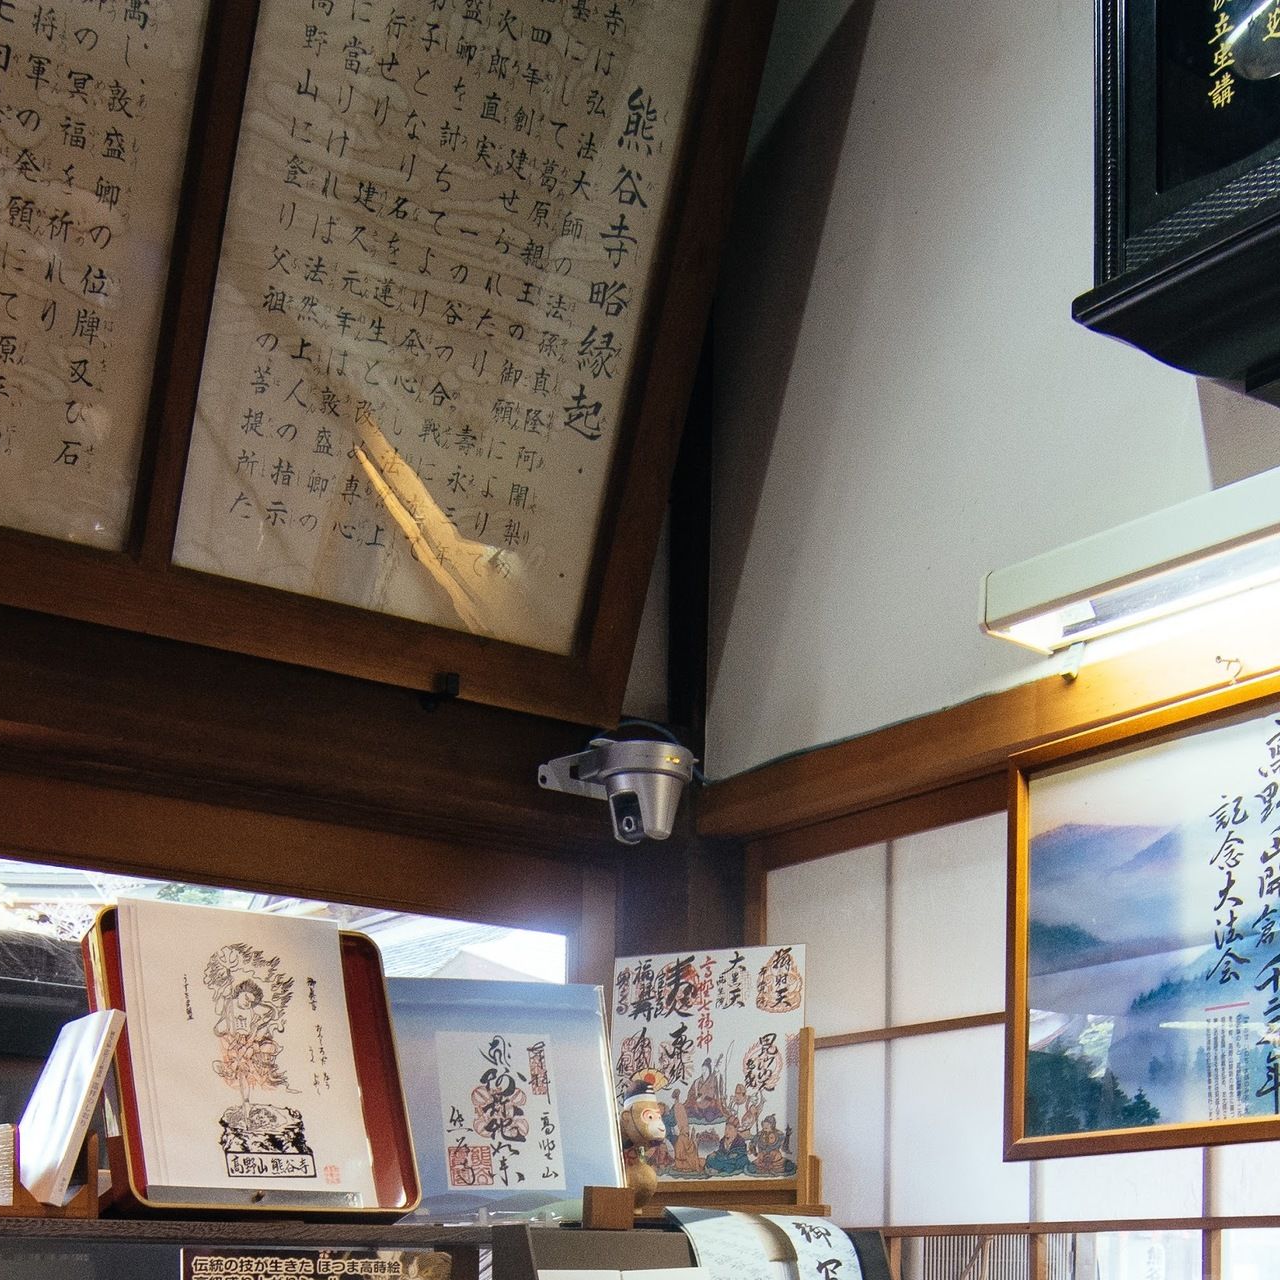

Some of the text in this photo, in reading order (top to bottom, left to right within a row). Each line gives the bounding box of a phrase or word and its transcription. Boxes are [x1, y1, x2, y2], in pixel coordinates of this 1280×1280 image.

[230, 1157, 268, 1174] 高野山
[271, 1157, 310, 1176] 熊谷寺
[193, 1257, 401, 1274] 伝統の技が生きた ほつま高蒔絵
